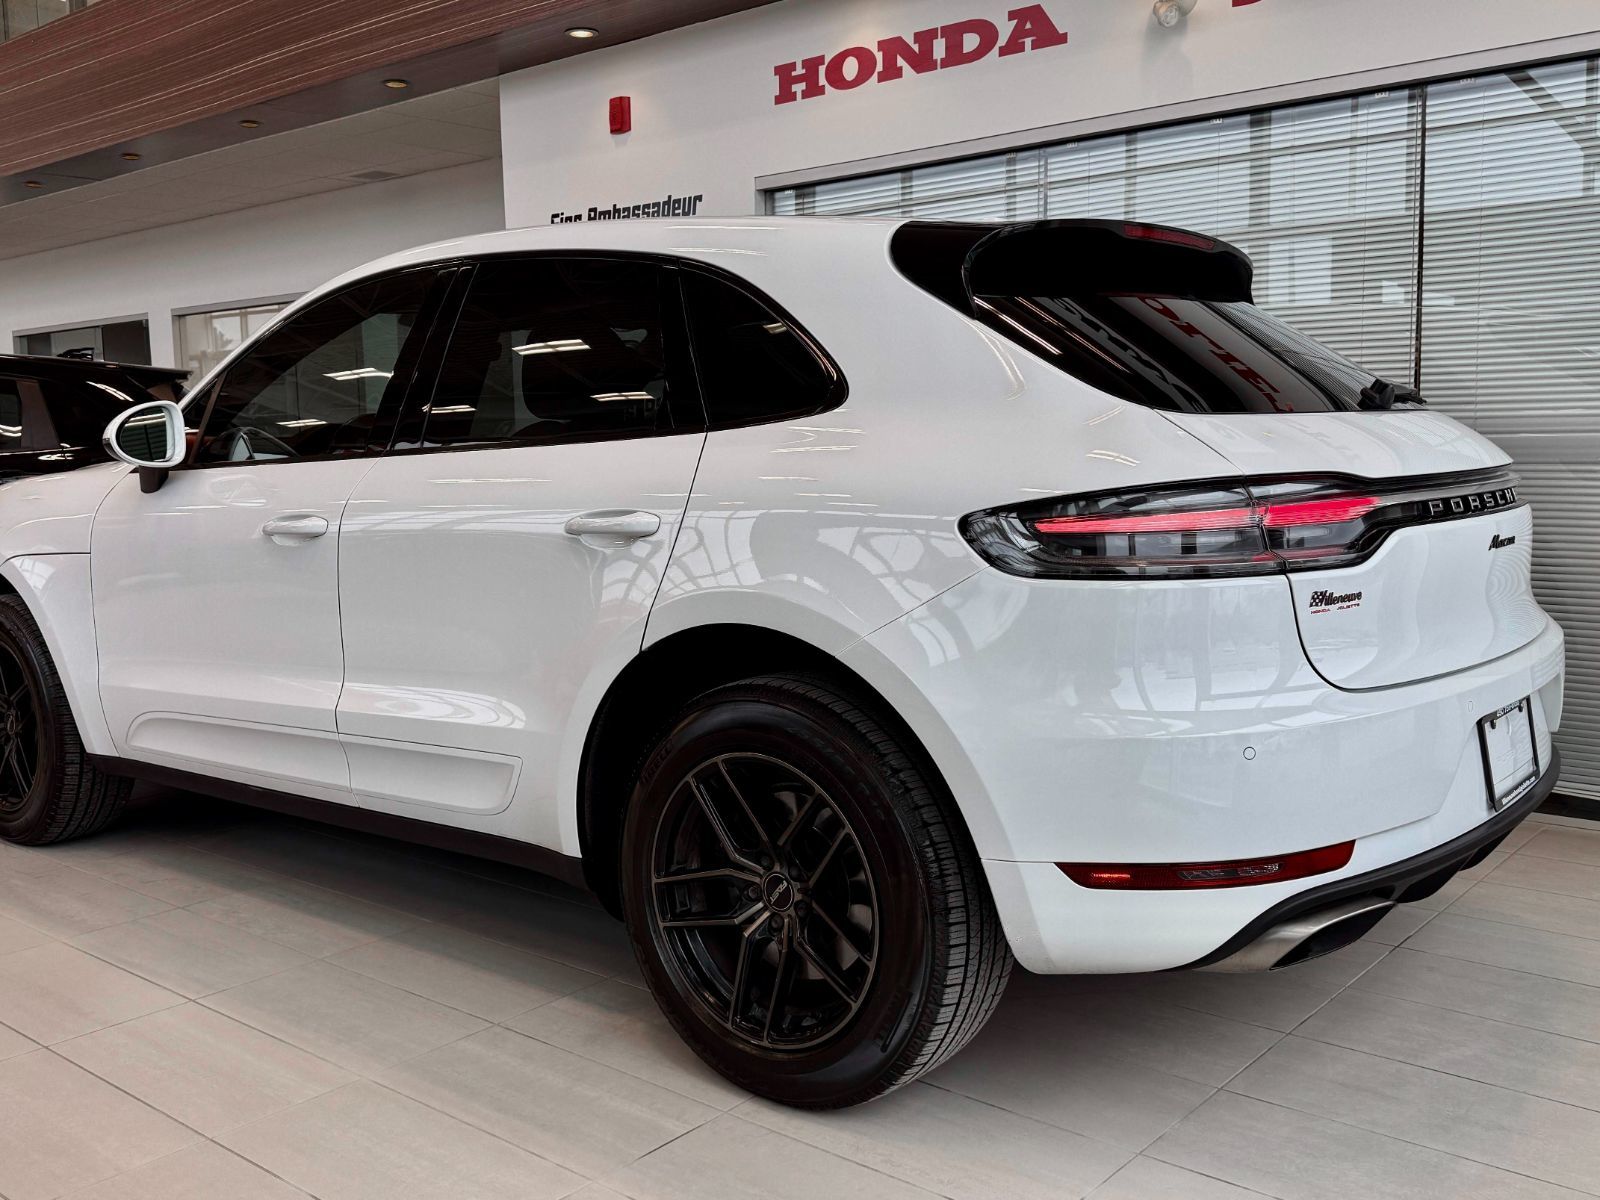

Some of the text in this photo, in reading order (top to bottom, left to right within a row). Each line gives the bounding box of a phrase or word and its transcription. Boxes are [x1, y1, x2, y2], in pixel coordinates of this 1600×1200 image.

[773, 3, 1068, 106] HONDA
[588, 195, 703, 221] Ambassadeur
[1429, 487, 1518, 516] PORSCH
[1488, 534, 1516, 551] Macan
[1316, 590, 1363, 607] Villeneuve
